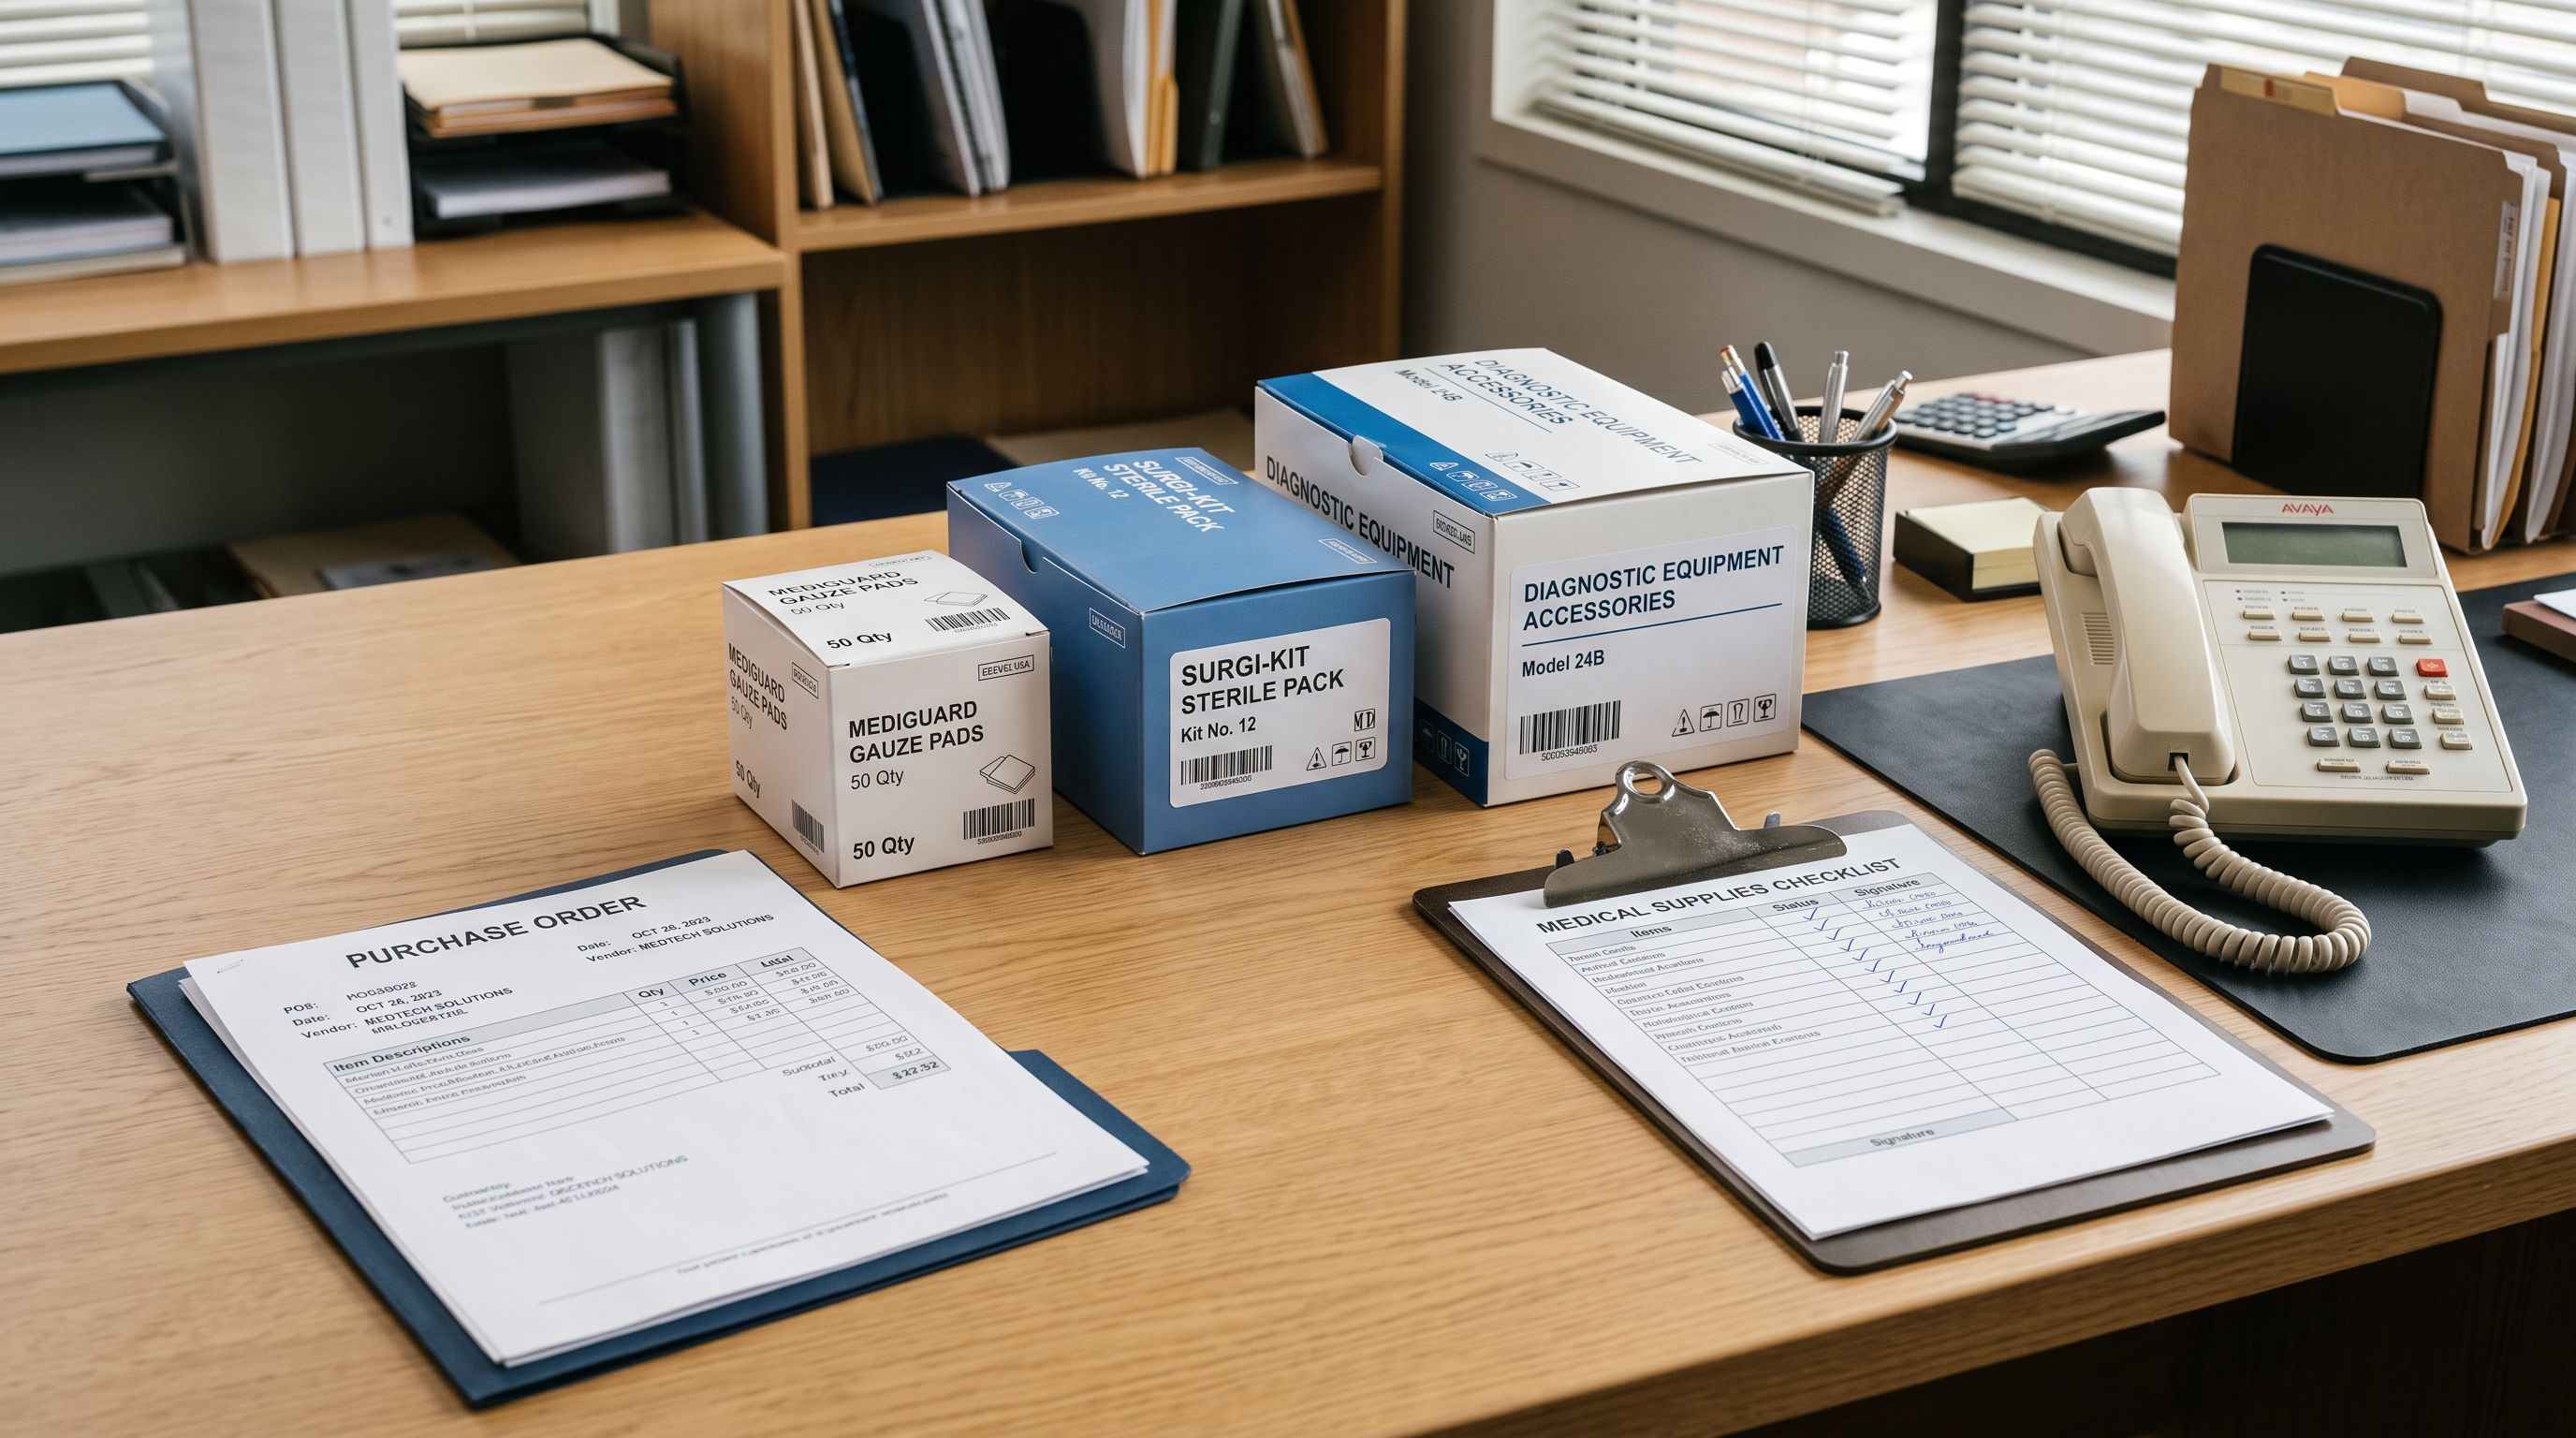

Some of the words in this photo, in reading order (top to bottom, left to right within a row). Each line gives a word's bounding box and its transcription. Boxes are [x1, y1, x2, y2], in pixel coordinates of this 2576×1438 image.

[1440, 362, 1573, 424] ACCESSORIES
[1474, 360, 1589, 410] DIAGNOSTIC
[1580, 410, 1703, 463] EQUIPMENT
[1104, 463, 1180, 505] STERILE
[1166, 504, 1224, 533] PACK
[1108, 489, 1129, 499] 12
[1134, 461, 1236, 513] SURGI-KIT
[1266, 456, 1354, 531] DIAGNOSTIC
[1359, 512, 1455, 589] EQUIPMENT
[2282, 503, 2334, 517] AVAYA
[768, 571, 901, 596] MEDIGUARD
[780, 587, 856, 605] GAUZE
[858, 578, 918, 592] PADS
[1524, 565, 1656, 603] DIAGNOSTIC
[1663, 545, 1785, 580] EQUIPMENT
[1523, 590, 1676, 631] ACCESSORIES
[827, 637, 851, 649] 50
[856, 631, 892, 644] Qty
[729, 642, 785, 703] MEDIGUARD
[1181, 646, 1310, 686] SURGI-KIT
[1522, 655, 1570, 677] Model
[1574, 649, 1604, 668] 24B
[730, 668, 760, 709] GAUZE
[762, 695, 787, 730] PADS
[1181, 681, 1277, 715] STERILE
[1284, 668, 1344, 697] PACK
[849, 701, 977, 738] MEDIGUARD
[1181, 726, 1203, 743] Kit
[1208, 722, 1234, 739] No.
[1238, 716, 1256, 733] 12
[850, 735, 923, 763] GAUZE
[929, 725, 984, 750] PADS
[736, 760, 745, 781] 50
[747, 770, 760, 799] Qty
[851, 773, 871, 790] 50
[876, 769, 904, 786] Qty
[853, 841, 875, 859] 50
[882, 836, 915, 856] Qty
[1536, 905, 1651, 933] MEDICAL
[1651, 884, 1769, 913] SUPPLIES
[1772, 858, 1902, 890] CHECKLIST
[1854, 878, 1921, 898] Signature
[345, 921, 529, 969] PURCHASE
[533, 896, 648, 929] ORDER
[632, 928, 658, 939] OCT
[638, 932, 702, 951] MEDTECH
[702, 914, 775, 935] SOLUTIONS
[638, 988, 664, 999] Qty
[292, 1015, 329, 1026] Date:
[356, 1002, 384, 1013] OCT
[300, 1022, 358, 1038] Vendor:
[364, 1005, 433, 1026] MEDTECH
[434, 988, 513, 1010] SOLUTIONS
[333, 1058, 370, 1072] Item
[372, 1035, 471, 1064] Descriptions
[827, 1083, 866, 1098] Total
[1870, 1128, 1935, 1147] Signature
